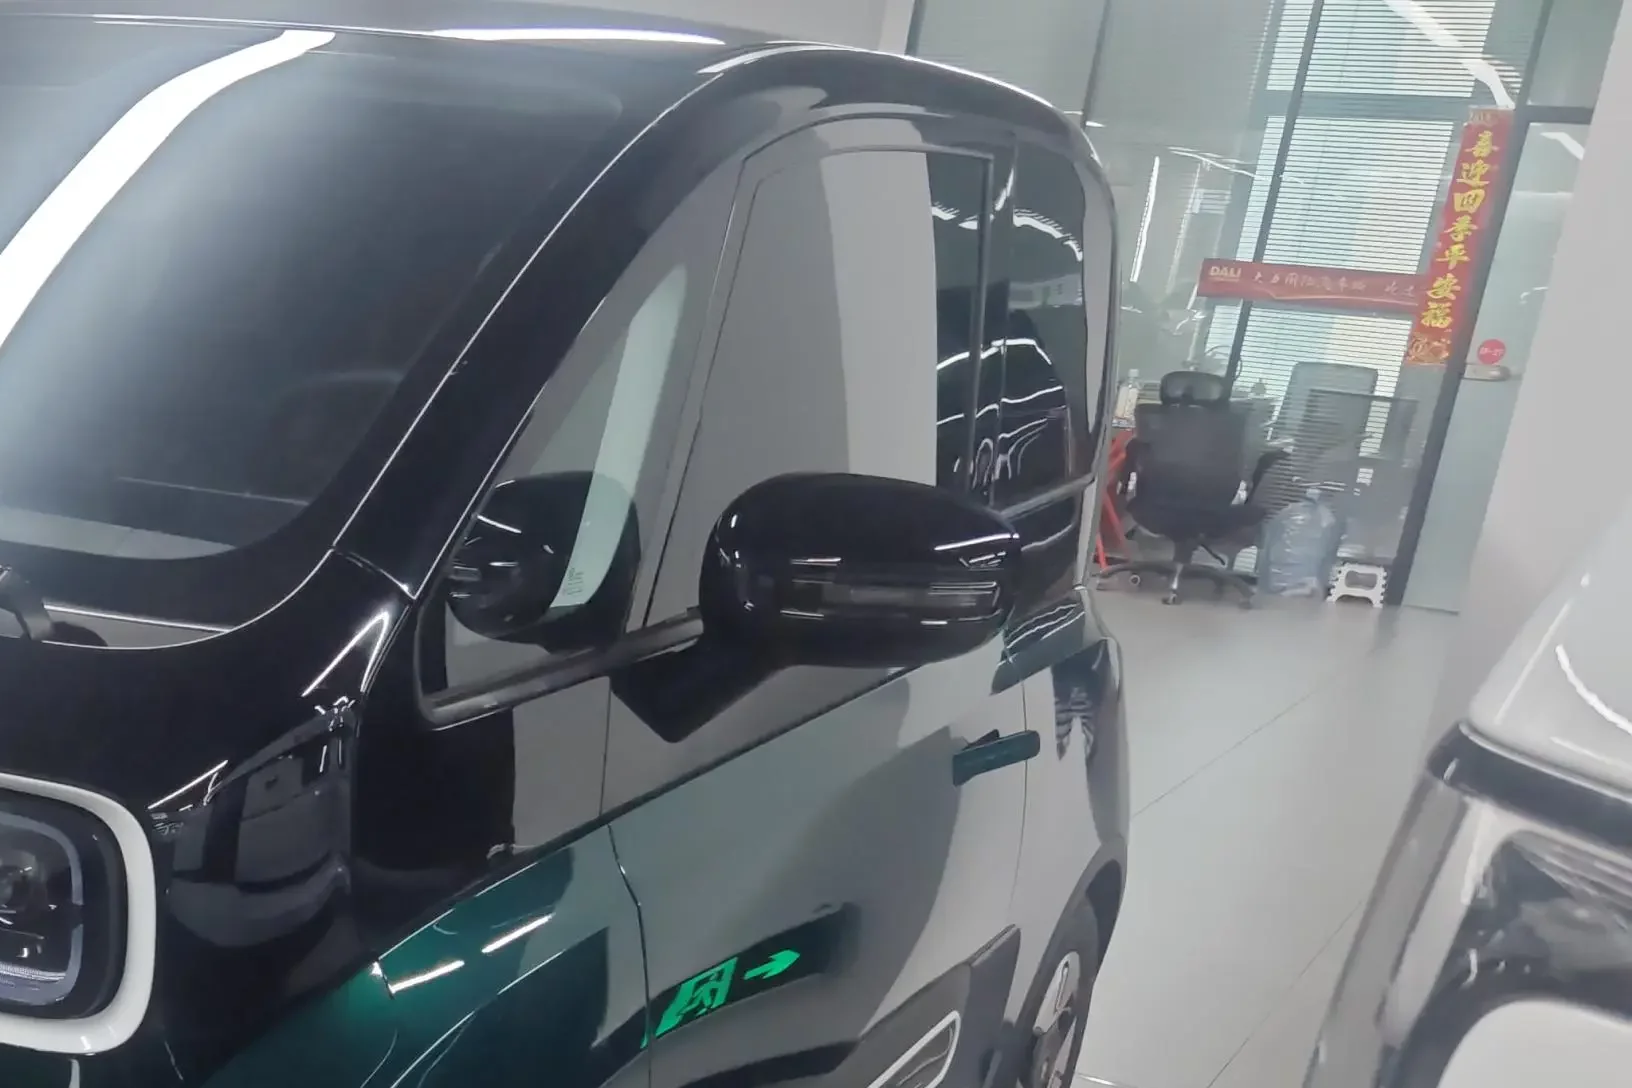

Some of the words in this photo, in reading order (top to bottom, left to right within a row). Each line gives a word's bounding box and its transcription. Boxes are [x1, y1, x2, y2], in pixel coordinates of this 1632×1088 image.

[1209, 266, 1241, 278] DALI
[1419, 130, 1499, 328] 喜迎四季平安福
